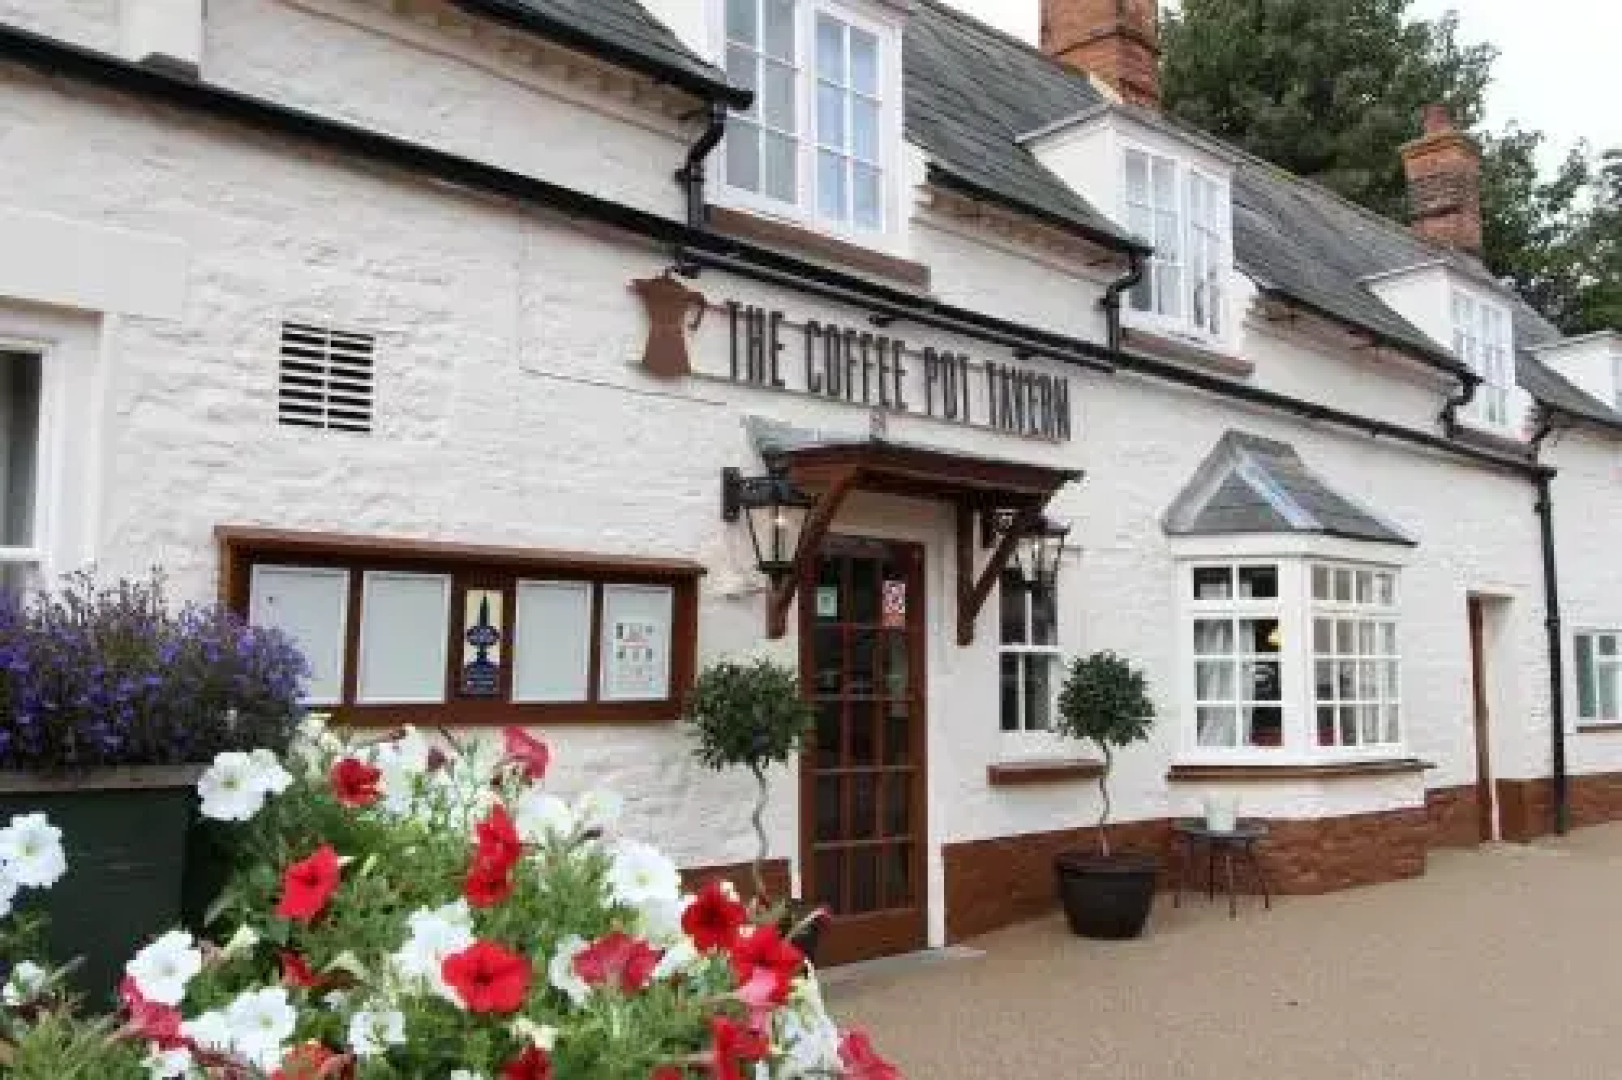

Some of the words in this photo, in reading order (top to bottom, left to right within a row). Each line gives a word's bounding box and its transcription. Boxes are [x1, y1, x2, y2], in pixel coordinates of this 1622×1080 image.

[727, 300, 785, 388] THE
[804, 319, 907, 411] COFFEE
[923, 346, 970, 426] POT
[984, 360, 1071, 442] TAVERN
